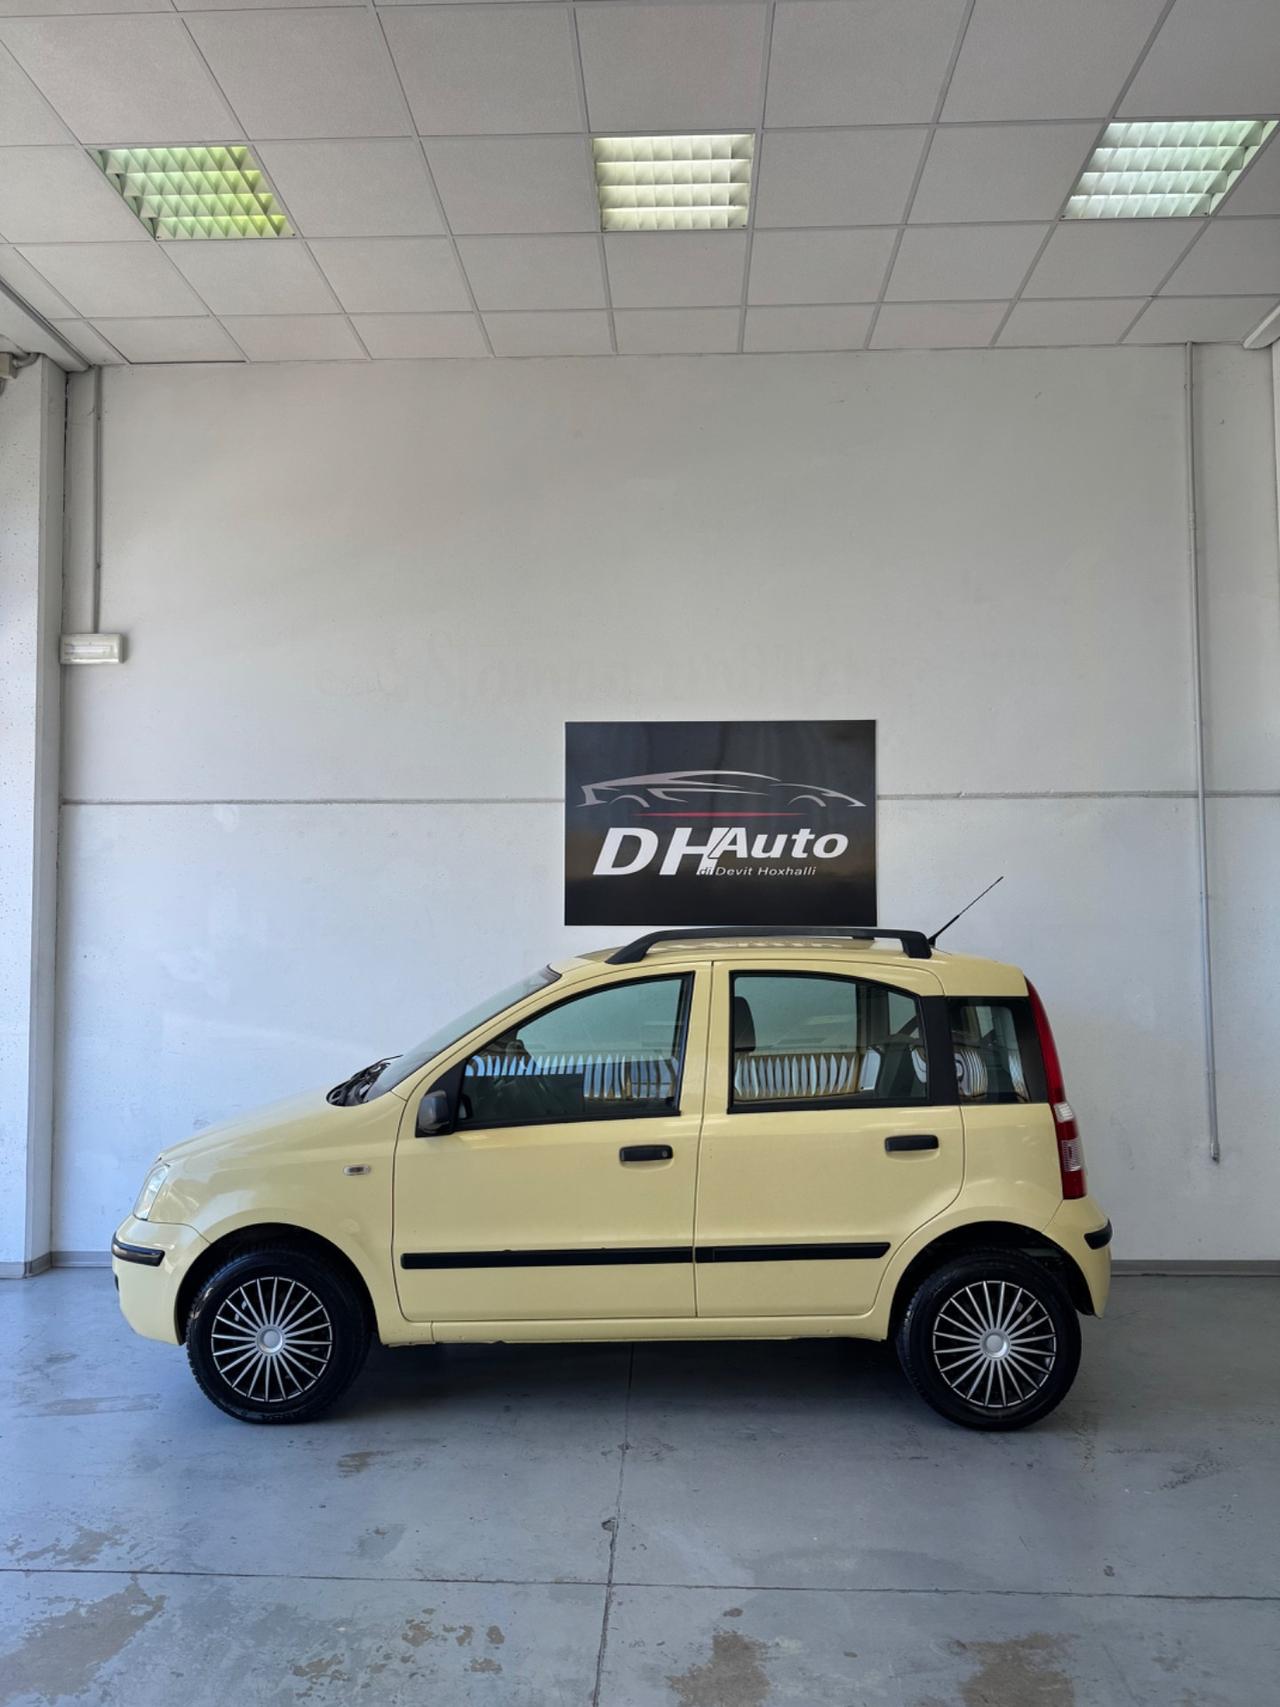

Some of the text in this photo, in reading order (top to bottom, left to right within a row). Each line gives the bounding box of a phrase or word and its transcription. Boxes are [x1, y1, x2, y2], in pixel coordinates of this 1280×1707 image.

[708, 827, 849, 859] Auto
[715, 866, 753, 876] Devit
[758, 866, 817, 876] Hoxhalli
